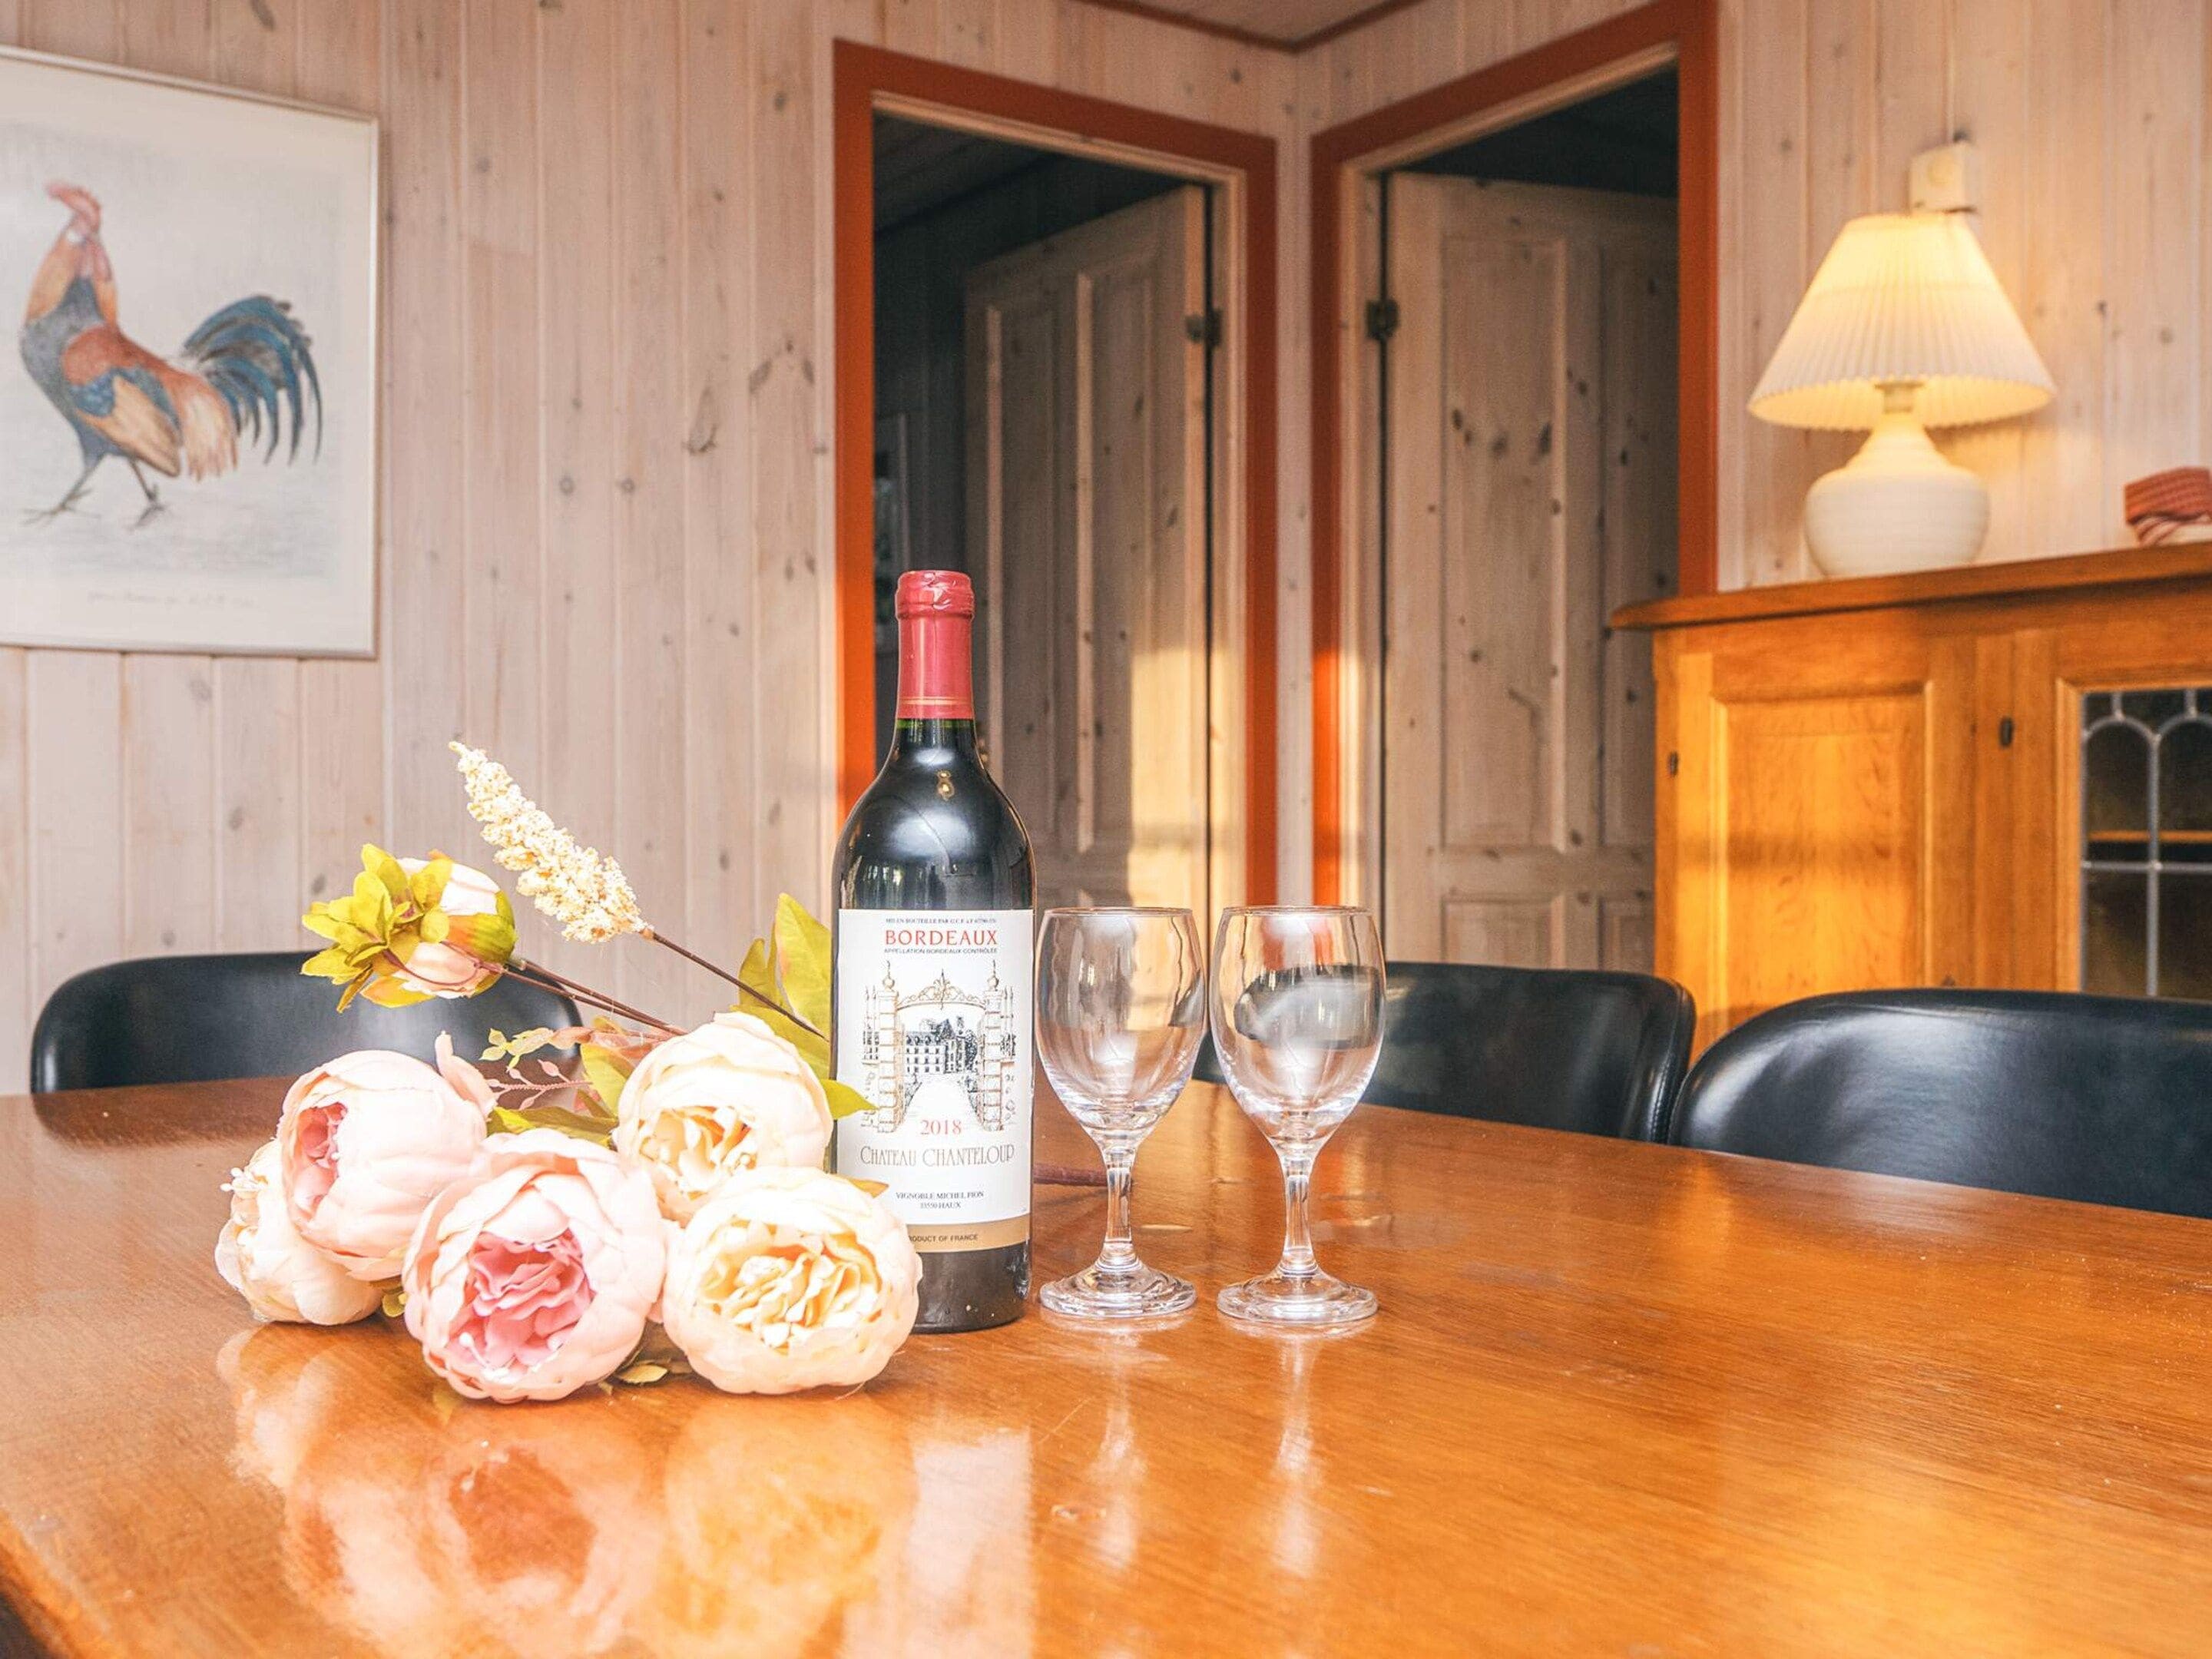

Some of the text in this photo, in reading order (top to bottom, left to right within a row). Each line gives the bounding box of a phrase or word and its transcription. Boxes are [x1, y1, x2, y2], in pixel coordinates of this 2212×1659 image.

[885, 929, 998, 945] BORDEAUX
[921, 1119, 963, 1135] 2018
[860, 1144, 1015, 1167] CHATEAU CHANTELOUP
